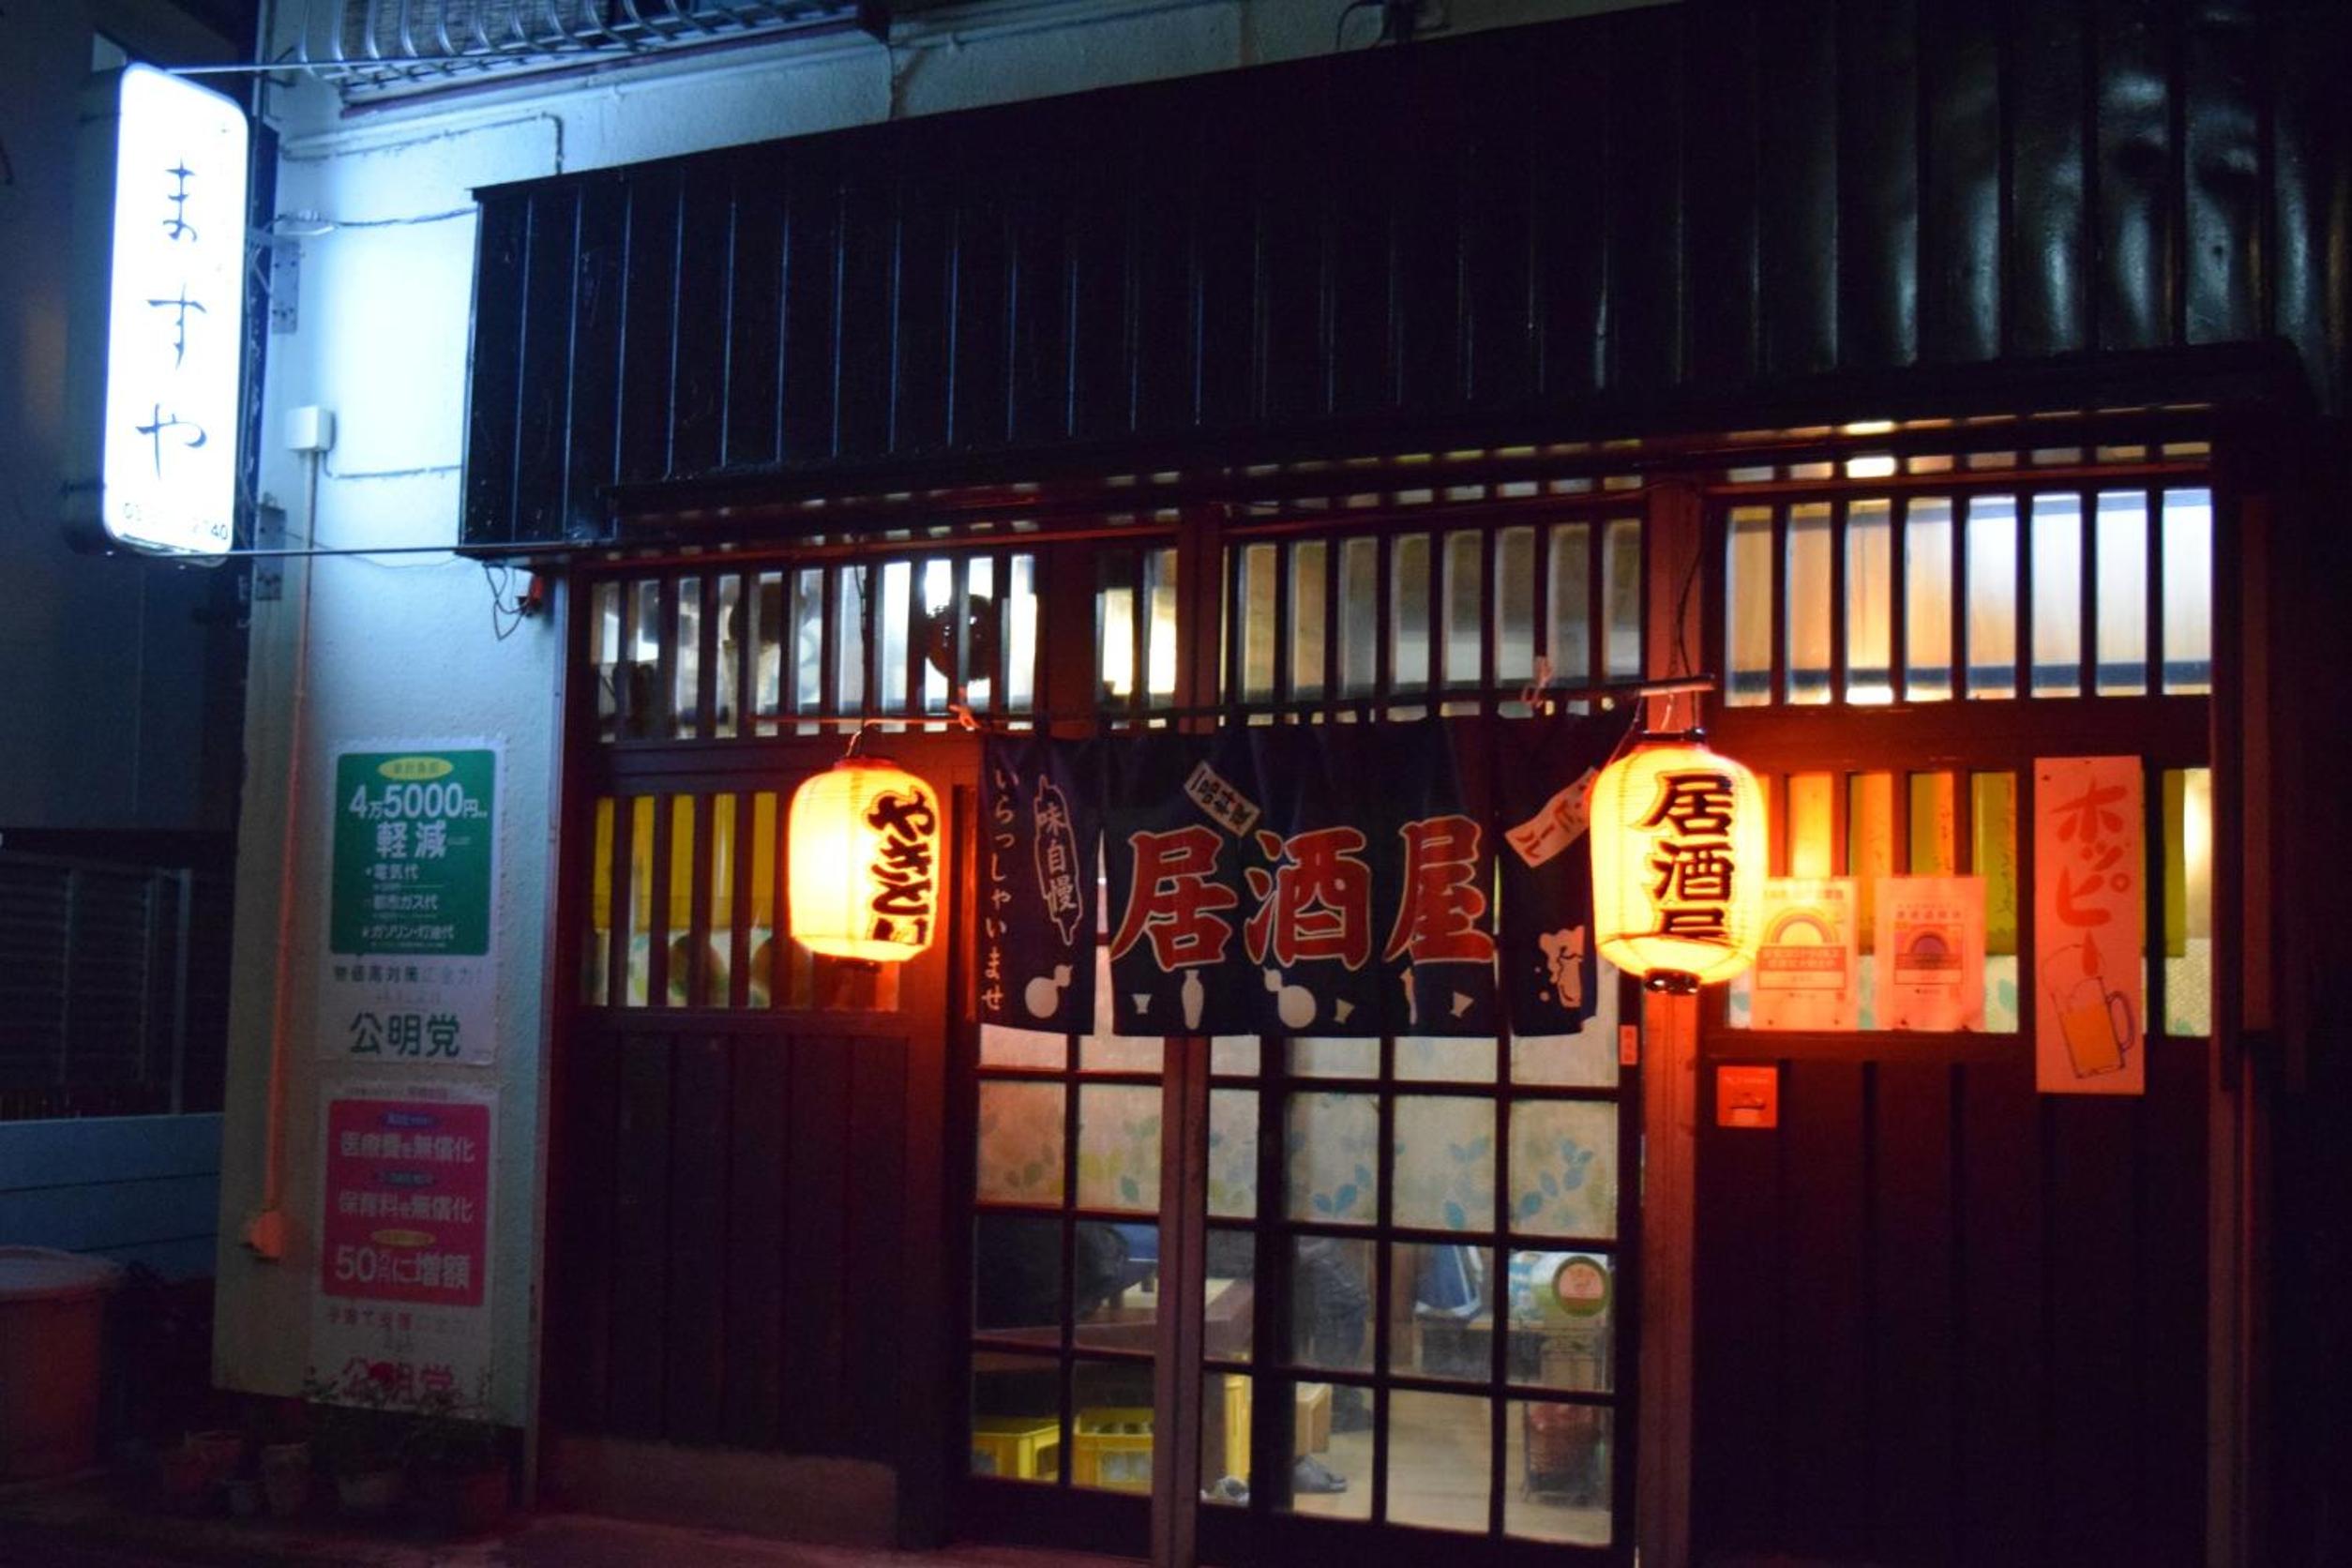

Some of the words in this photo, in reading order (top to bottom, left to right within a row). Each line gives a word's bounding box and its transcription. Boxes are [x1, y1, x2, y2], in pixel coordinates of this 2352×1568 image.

[134, 158, 207, 480] ますや
[375, 820, 448, 859] 軽減
[981, 768, 1020, 1012] いらっしゃいませ
[1035, 802, 1078, 913] 味自慢
[1110, 814, 1495, 972] 居酒屋
[2050, 778, 2132, 977] ホッピー
[350, 1012, 460, 1058] 公明党
